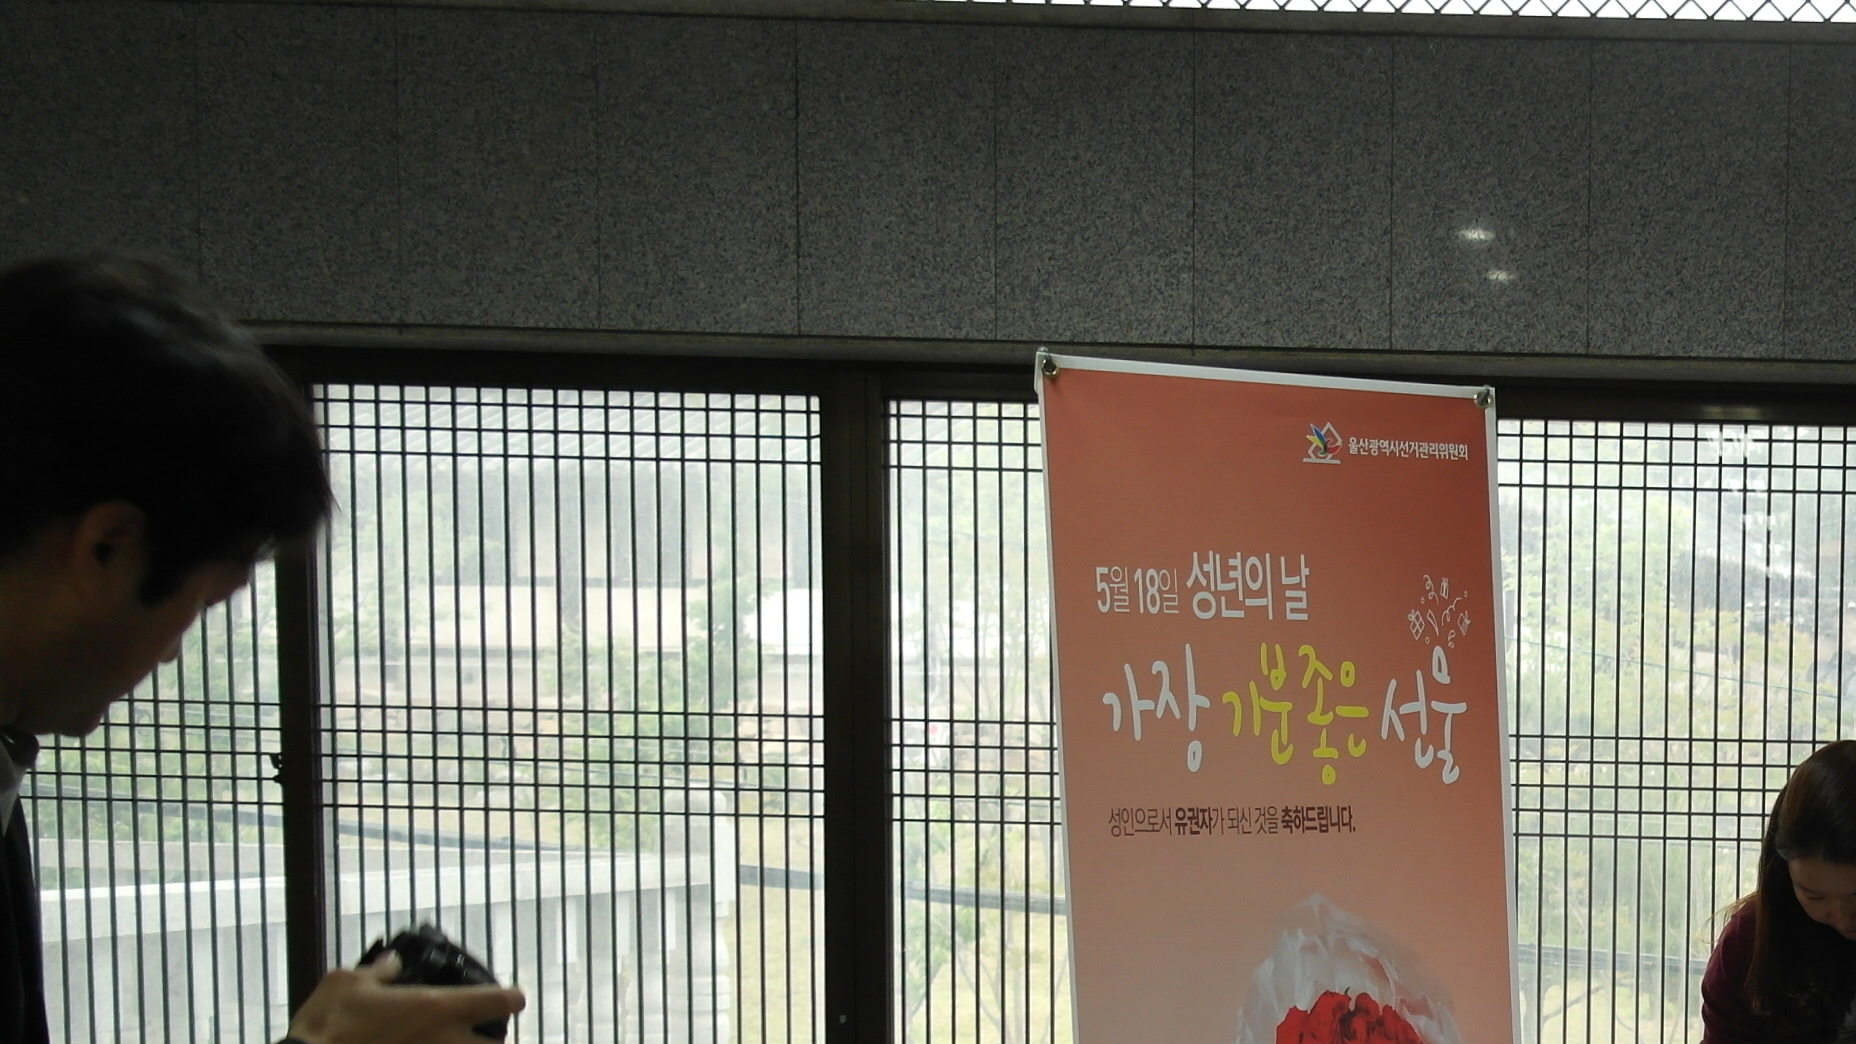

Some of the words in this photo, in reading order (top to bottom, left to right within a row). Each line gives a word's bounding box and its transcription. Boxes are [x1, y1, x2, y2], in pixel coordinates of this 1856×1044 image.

[1348, 436, 1469, 461] 울산광역시선거관리위원회
[1096, 566, 1130, 614] 5월
[1134, 568, 1180, 614] 18일
[1187, 550, 1274, 621] 성년의
[1280, 553, 1311, 621] 날
[1103, 643, 1211, 773] 가장
[1222, 642, 1294, 766] 기분
[1299, 644, 1370, 786] 좋은
[1381, 645, 1468, 785] 선물
[1108, 806, 1173, 838] 성인으로서
[1174, 806, 1225, 836] 유권자가
[1281, 805, 1356, 834] 축하드립니다.
